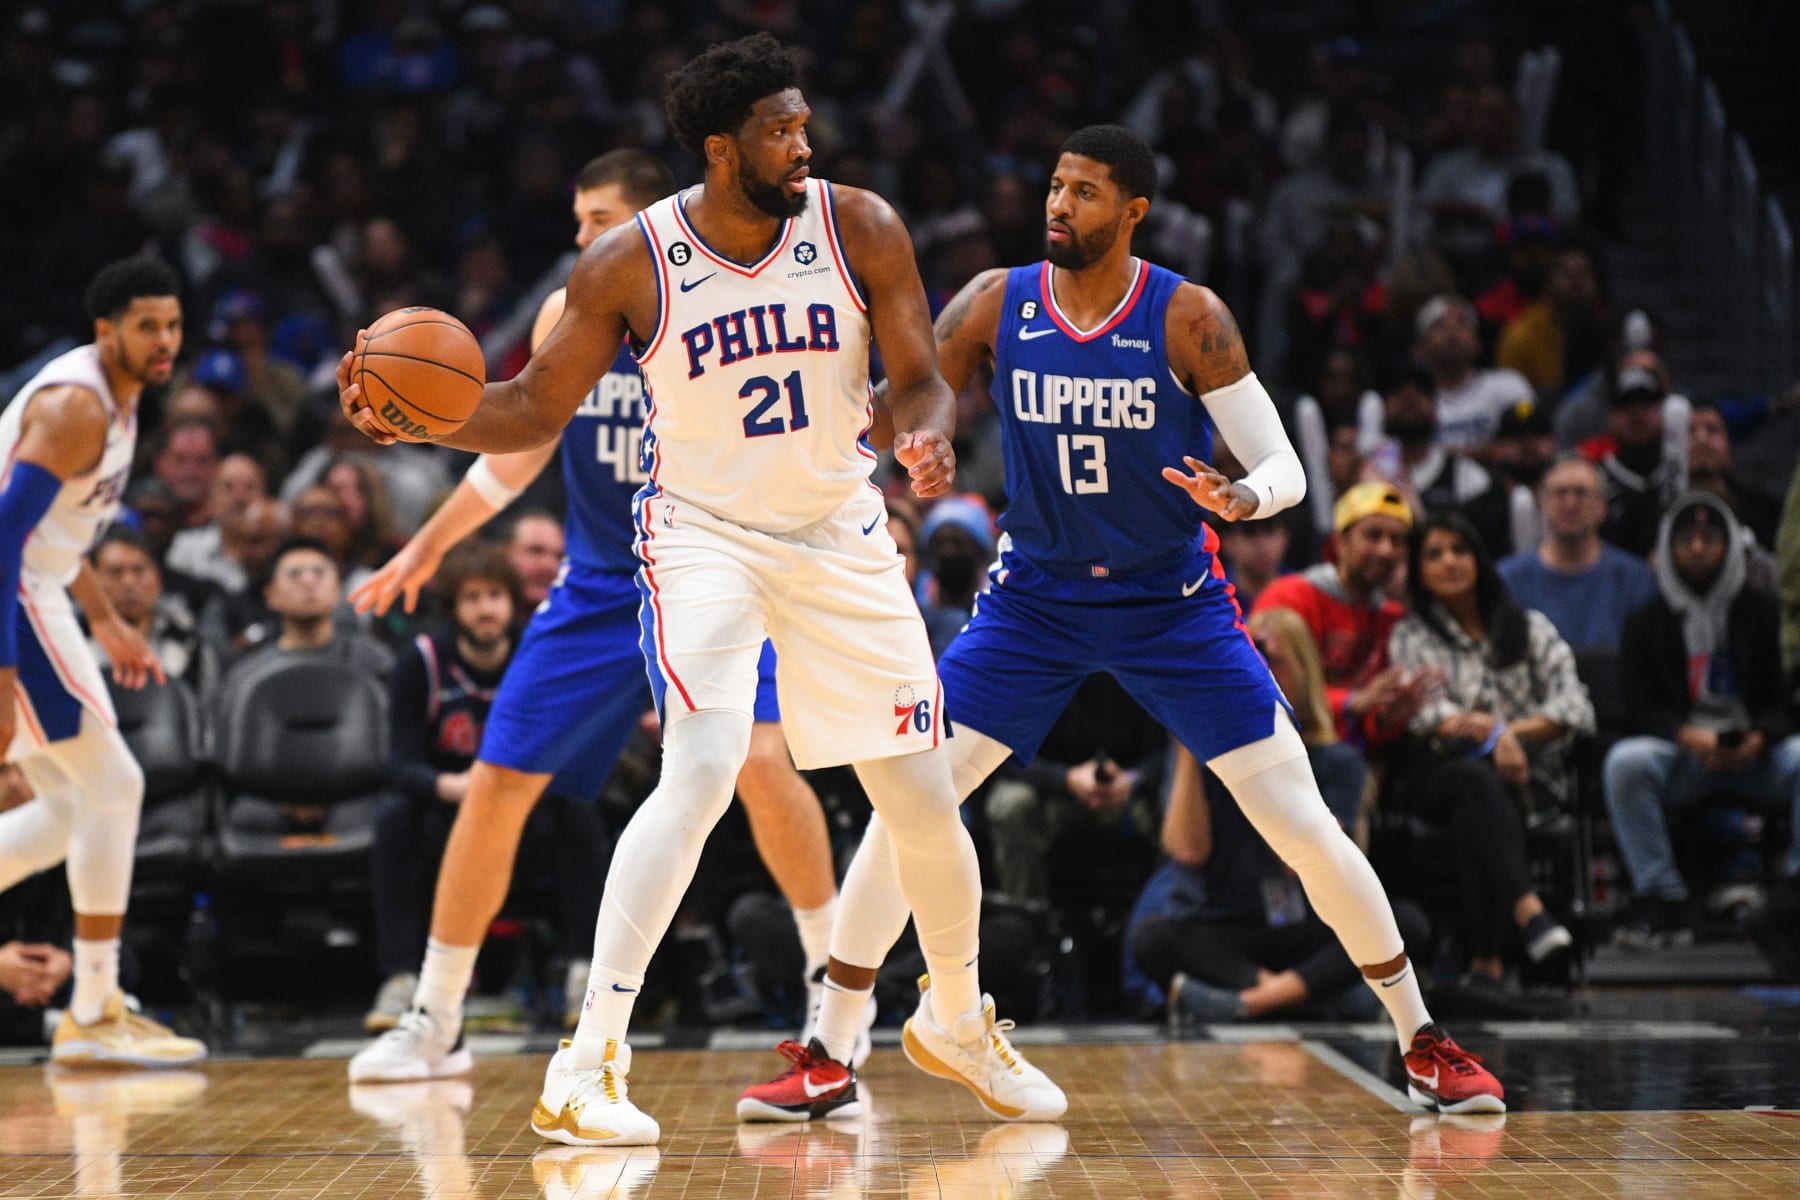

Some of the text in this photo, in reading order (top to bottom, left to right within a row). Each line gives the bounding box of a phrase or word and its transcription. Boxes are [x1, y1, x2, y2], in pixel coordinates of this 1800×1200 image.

[672, 245, 688, 263] 6
[787, 265, 831, 279] crypto.com
[1021, 301, 1037, 320] 6
[681, 303, 840, 381] PHILA
[1111, 333, 1151, 353] honey
[381, 398, 446, 439] Wilso
[738, 370, 809, 438] 21
[1012, 368, 1156, 430] CLIPPERS
[1057, 434, 1109, 494] 13
[894, 699, 931, 736] 76
